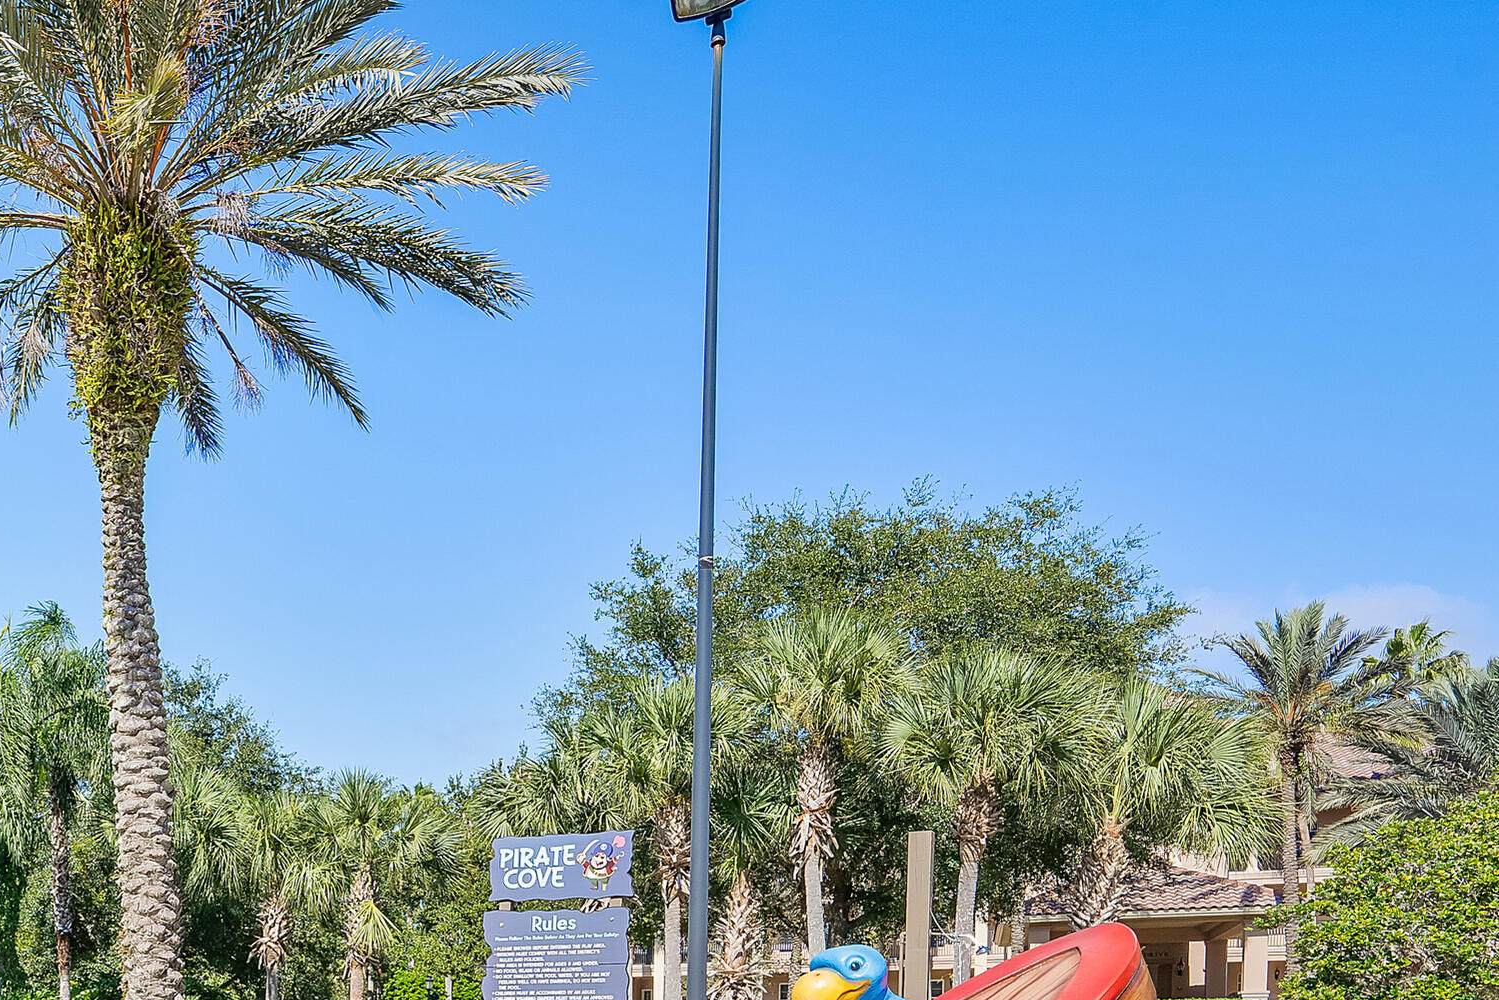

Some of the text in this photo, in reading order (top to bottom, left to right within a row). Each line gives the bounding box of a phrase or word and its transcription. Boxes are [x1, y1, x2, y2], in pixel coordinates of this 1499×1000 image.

[499, 844, 576, 869] PIRATE
[503, 866, 564, 889] COVE
[531, 914, 577, 931] Rules
